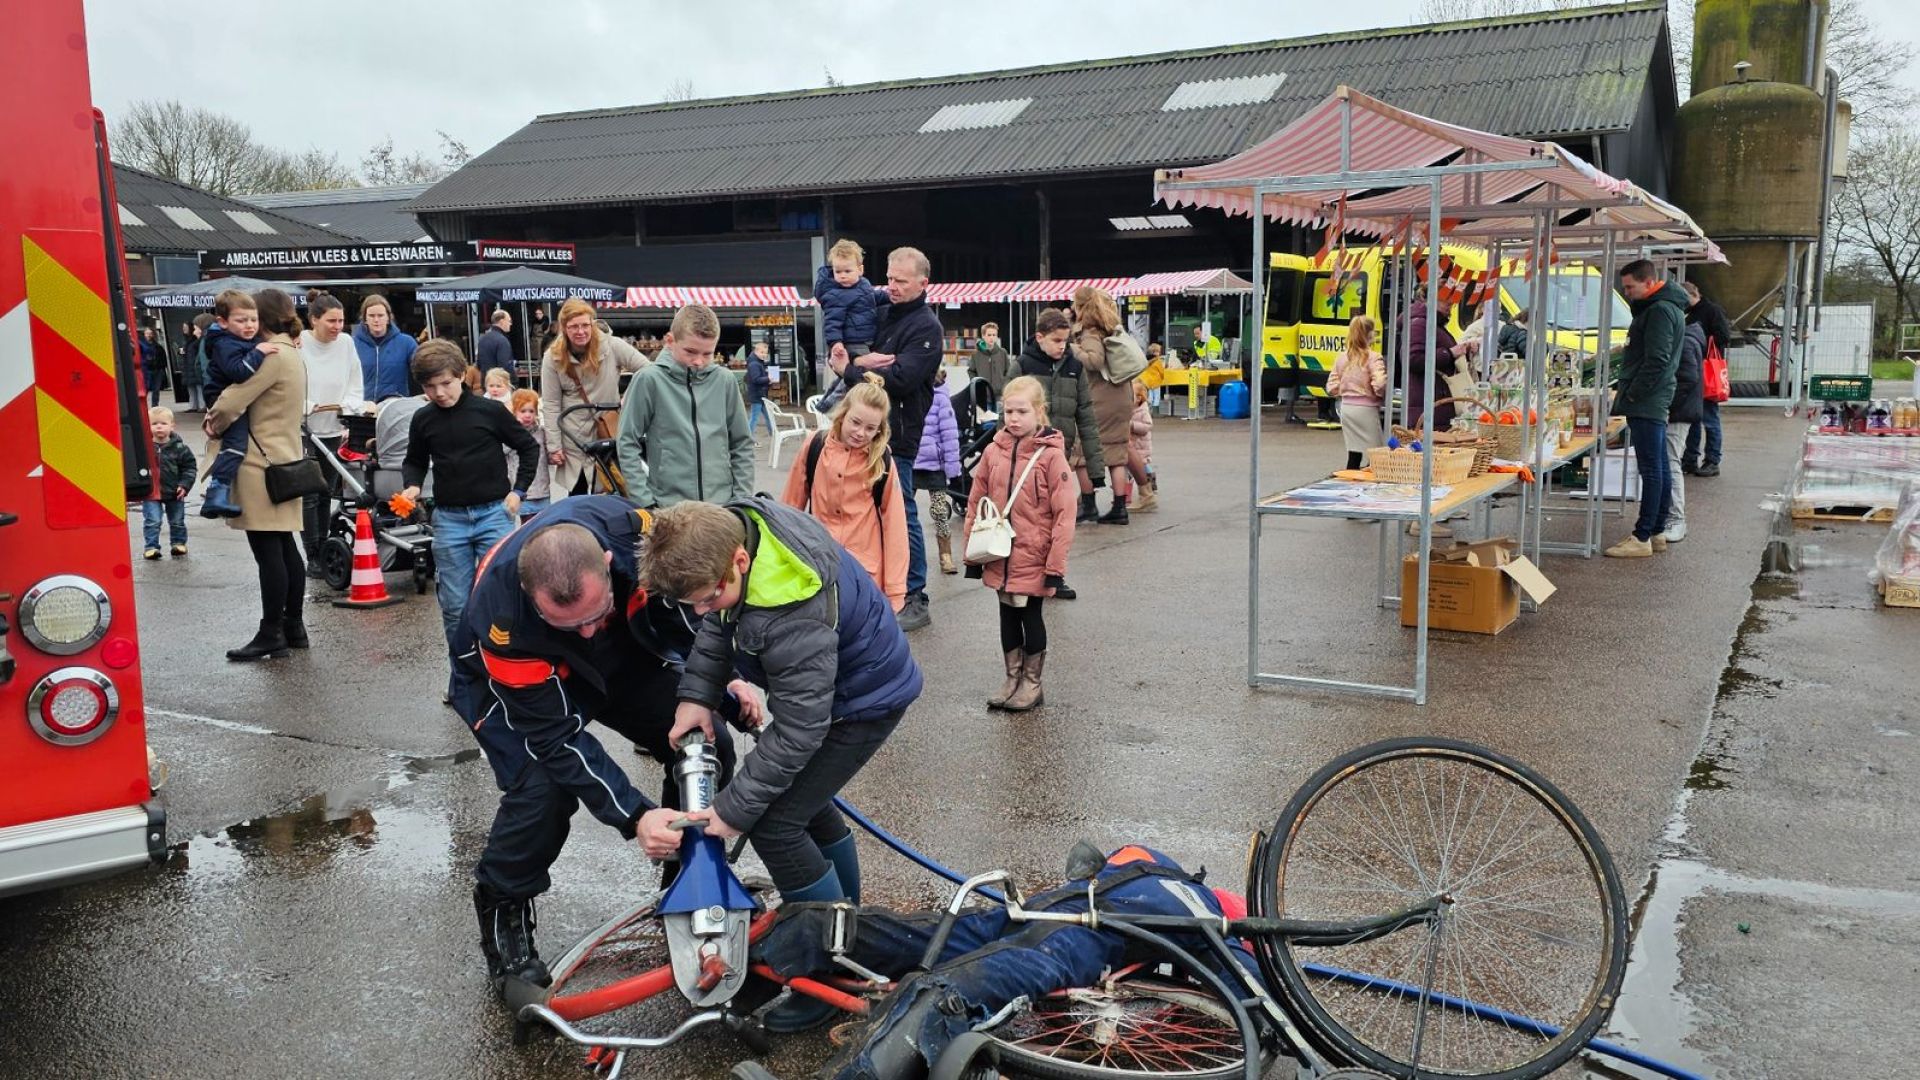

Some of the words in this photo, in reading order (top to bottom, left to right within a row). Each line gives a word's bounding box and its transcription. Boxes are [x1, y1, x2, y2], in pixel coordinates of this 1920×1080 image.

[226, 250, 310, 266] AMBACHTELIJK
[312, 249, 348, 263] VLEES
[351, 249, 359, 262] &
[360, 246, 444, 262] VLEESWAREN
[482, 247, 547, 260] AMBACHTELIJK
[548, 249, 573, 261] VLEES
[502, 288, 566, 301] MARKTSLAGERIJ
[569, 287, 612, 300] SLOOTWEG
[1299, 334, 1346, 352] BULANCE
[698, 777, 710, 810] UKAS
